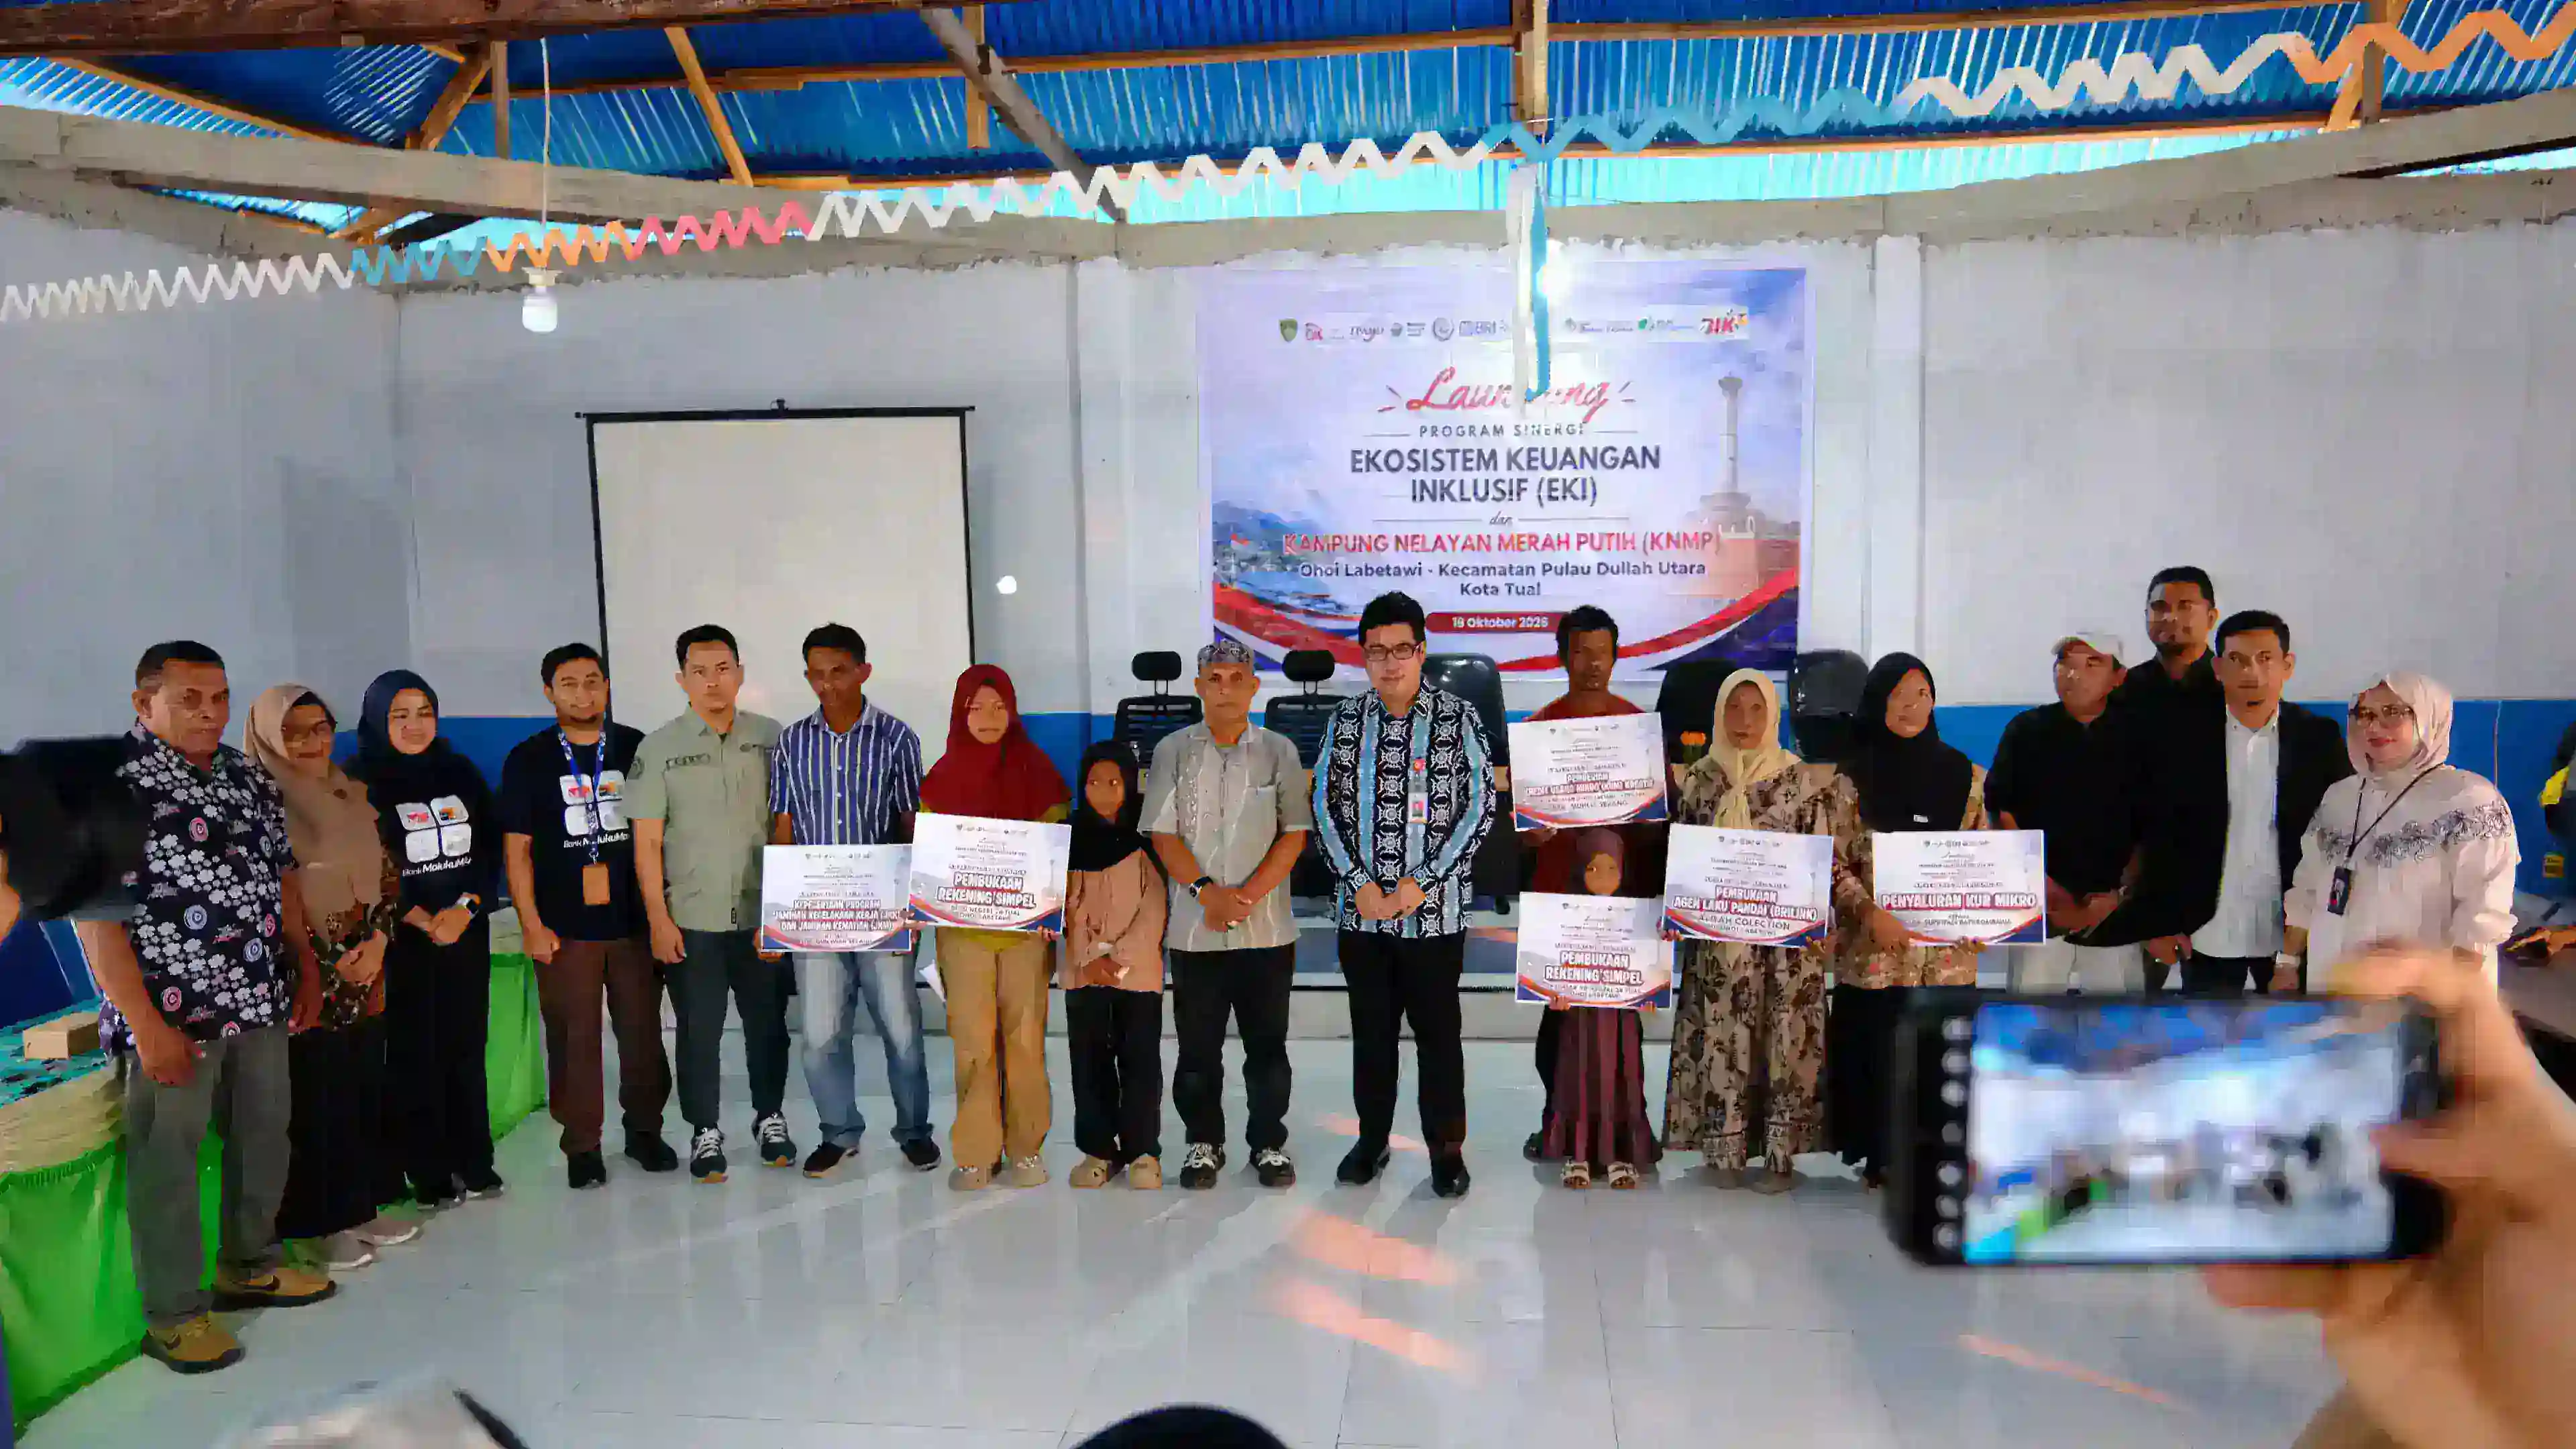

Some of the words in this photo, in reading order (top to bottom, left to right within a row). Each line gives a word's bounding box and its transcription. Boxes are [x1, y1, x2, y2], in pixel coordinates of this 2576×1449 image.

[1405, 366, 1610, 423] Launng
[1419, 425, 1504, 437] PROGRAM
[1514, 422, 1584, 437] SINERGI
[1350, 447, 1497, 473] EKOSISTEM
[1507, 445, 1660, 471] KEUANGAN
[1412, 478, 1528, 502] INKLUSIF
[1537, 476, 1597, 508] (EKI)
[1283, 534, 1389, 555] KAMPUNG
[1394, 534, 1492, 553] NELAYAN
[1498, 533, 1570, 552] MERAH
[1576, 532, 1635, 551] PUTIH
[1643, 531, 1721, 555] (KNMP)
[1300, 561, 1340, 578] Ohoi
[1344, 561, 1423, 578] Labetawi
[1439, 562, 1536, 578] Kecamatan
[1542, 561, 1591, 576] Pulau
[1597, 561, 1653, 576] Dullah
[1658, 561, 1706, 575] Utara
[1460, 582, 1499, 596] Kota
[1505, 581, 1541, 596] Tual
[1466, 615, 1517, 629] Oktober
[954, 872, 1024, 892] PEMBUKAAN
[937, 887, 993, 905] REKENING
[994, 892, 1036, 908] SIMPEL
[1715, 886, 1778, 903] PEMBUKAAN
[1882, 894, 1963, 909] PENYALURAN
[1994, 893, 2038, 908] MIKRO
[1702, 899, 1729, 912] LAKU
[1730, 902, 1767, 917] PANDAI
[1560, 951, 1630, 969] PEMBUKAAN
[1544, 965, 1600, 982] REKENING
[1601, 969, 1644, 985] SIMPEL
